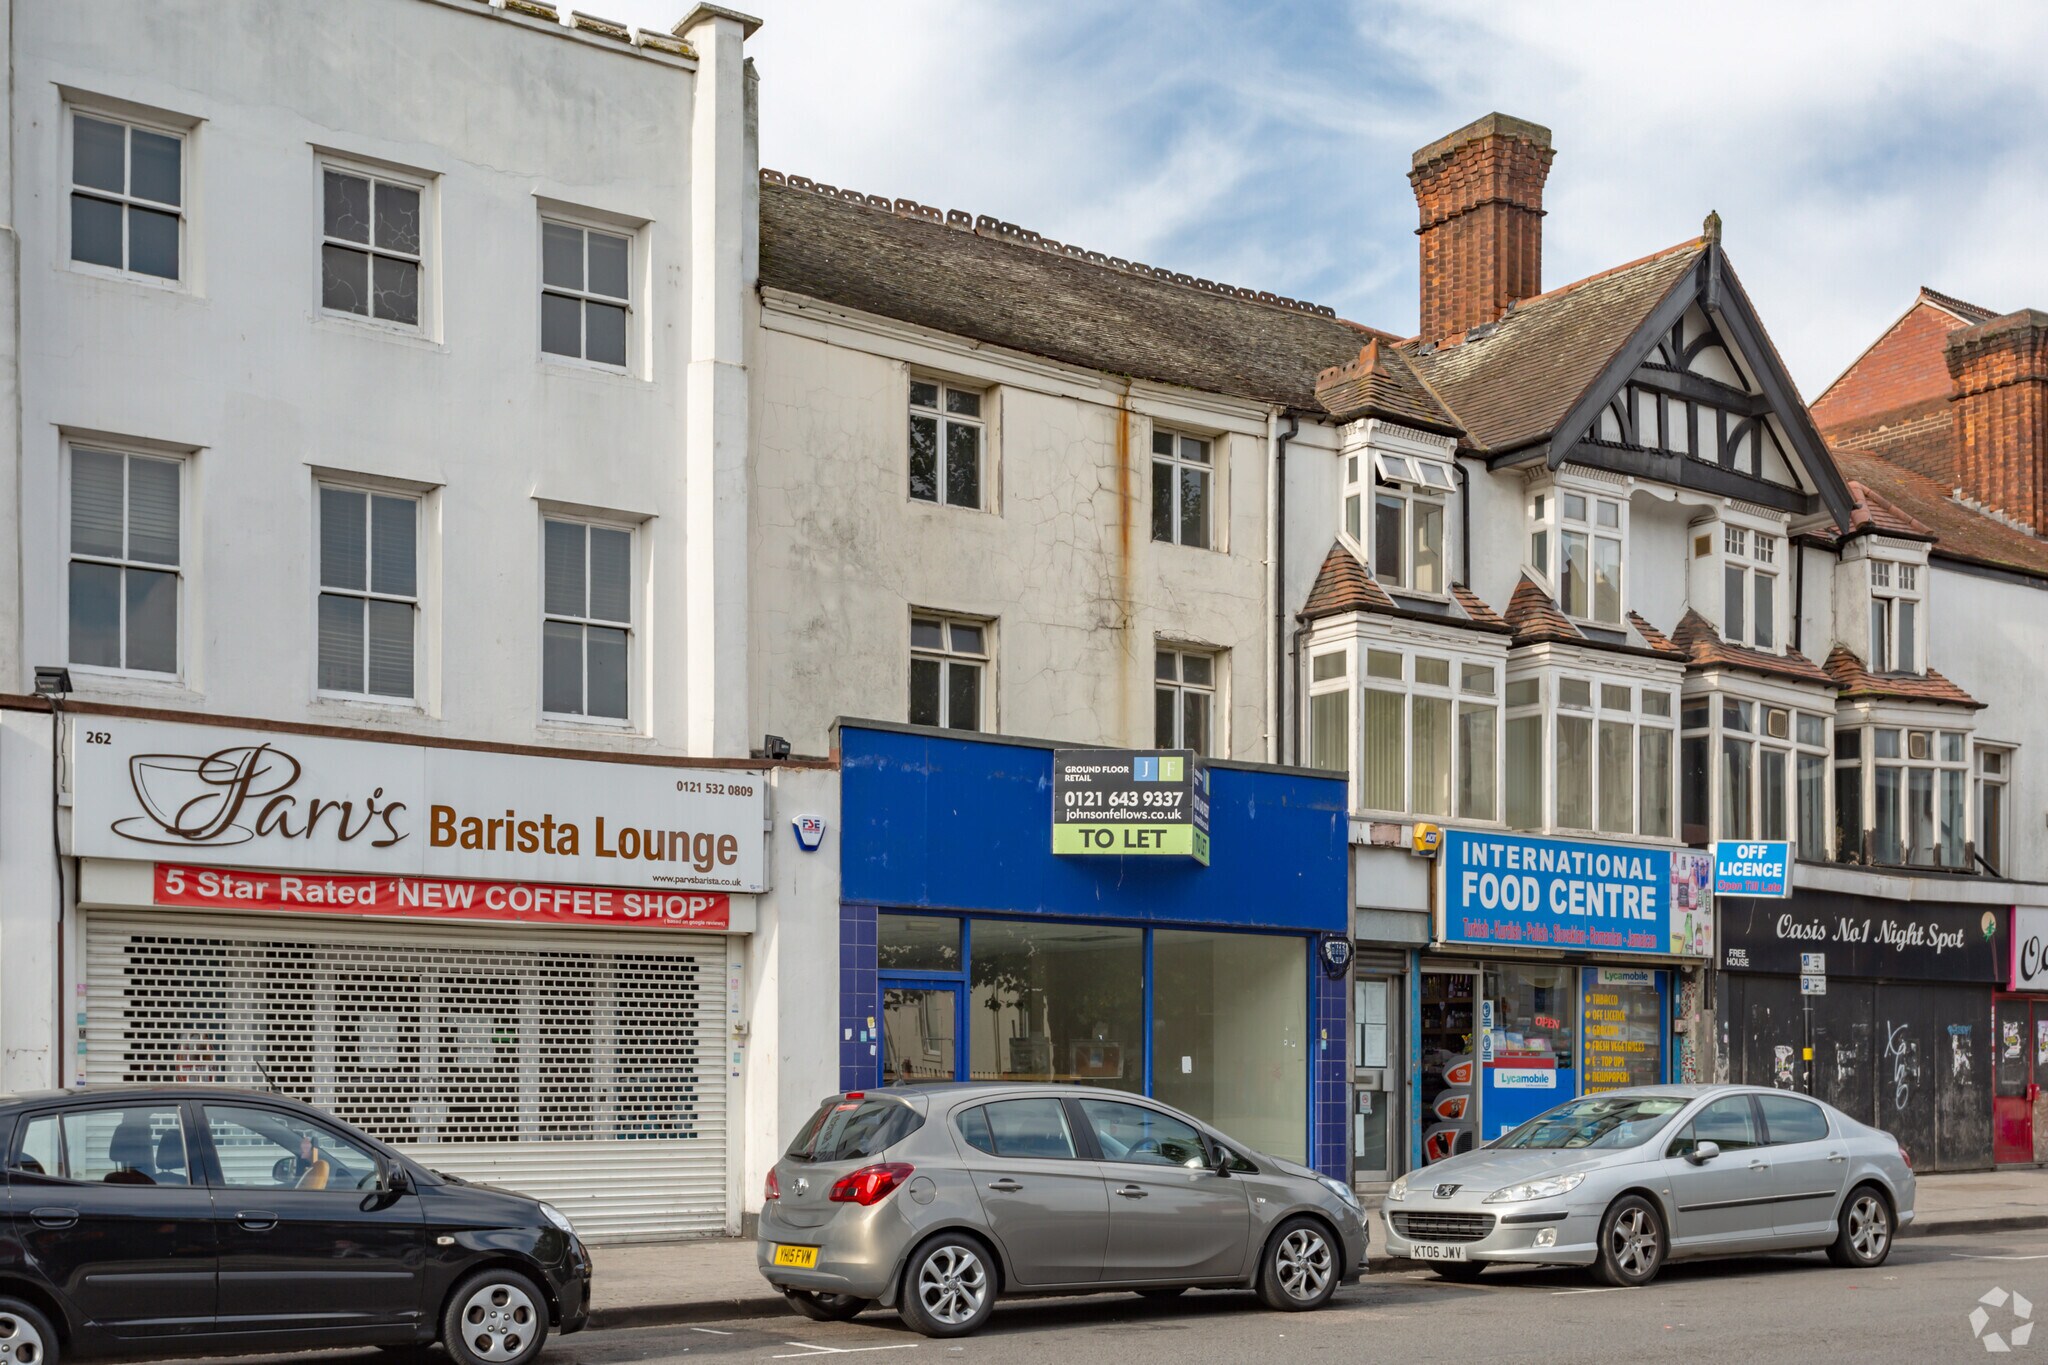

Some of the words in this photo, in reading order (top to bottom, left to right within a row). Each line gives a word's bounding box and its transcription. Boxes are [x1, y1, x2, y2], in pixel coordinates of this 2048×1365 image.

[85, 731, 112, 745] 262
[1064, 765, 1101, 774] GROUND
[1102, 765, 1129, 774] FLOOR
[1064, 774, 1092, 782] RETAIL
[676, 780, 701, 793] 0121
[705, 782, 725, 795] 532
[728, 784, 753, 797] 0809
[1064, 791, 1102, 806] 0121
[1108, 791, 1139, 806] 643
[1142, 791, 1184, 806] 9337
[1065, 808, 1182, 821] johnsonfellows.co.uk
[430, 804, 579, 856] Barista
[595, 816, 738, 874] Lounge
[1079, 828, 1114, 849] TO
[1124, 829, 1167, 848] LET
[1737, 845, 1767, 859] OFF
[1462, 841, 1657, 881] INTERNATIONAL
[1719, 861, 1783, 877] LICENCE
[652, 874, 742, 886] www.parvsbarista.co.uk
[1717, 879, 1742, 893] Open
[1745, 879, 1759, 891] Till
[1761, 881, 1782, 893] Late
[165, 869, 185, 895] 5
[197, 871, 269, 900] Star
[280, 877, 377, 905] Rated
[485, 885, 613, 916] COFFEE
[1462, 871, 1540, 912] FOOD
[1549, 877, 1657, 921] CENTRE
[1463, 917, 1489, 939] Turkish
[1494, 919, 1522, 941] Kurdish
[1526, 922, 1549, 943] Polish
[1553, 924, 1586, 944] Slovakian
[1590, 925, 1623, 946] Romanian
[1627, 929, 1657, 948] Jamaican
[1776, 914, 1826, 940] Oasis
[1832, 918, 1871, 942] No1
[1874, 919, 1924, 952] Night
[1925, 924, 1965, 954] Spot
[1728, 948, 1746, 958] FREE
[1726, 957, 1749, 967] HOUSE
[1604, 970, 1649, 982] Lycamobile
[1535, 1016, 1560, 1029] OPEN
[1592, 1009, 1603, 1021] OFF
[1604, 1009, 1626, 1022] LICENCE
[1592, 1040, 1610, 1052] FRESH
[1611, 1041, 1645, 1053] VEGETABLES
[1601, 1056, 1613, 1067] TOP
[1613, 1056, 1625, 1068] UPS
[1501, 1073, 1549, 1084] Lycamobile
[1592, 1072, 1630, 1083] NEWSPAPERS
[795, 1249, 813, 1264] FVM
[1413, 1245, 1440, 1259] KT06
[1442, 1246, 1462, 1259] JWV
